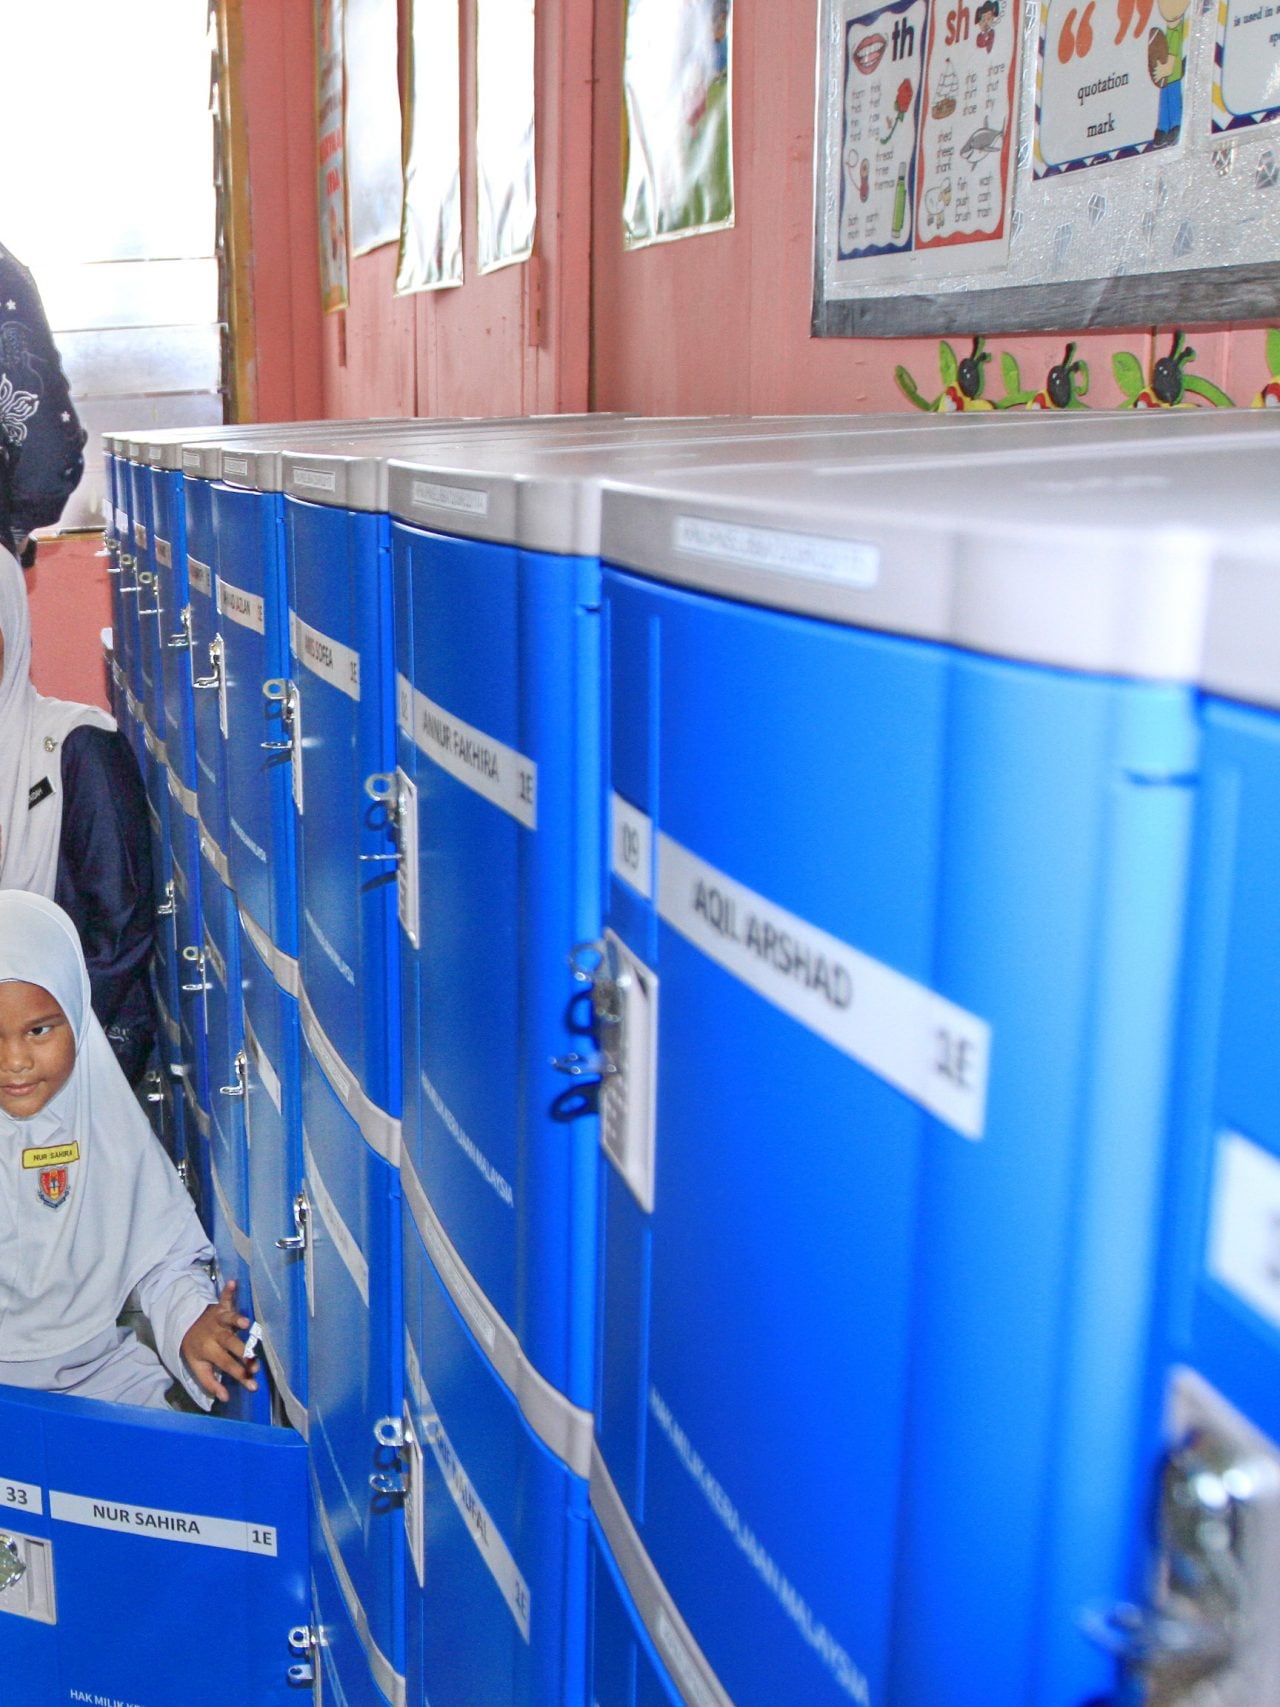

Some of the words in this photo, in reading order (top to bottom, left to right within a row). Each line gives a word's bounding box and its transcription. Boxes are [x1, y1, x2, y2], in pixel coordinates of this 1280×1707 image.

[892, 17, 915, 61] th
[945, 0, 970, 46] sh
[1077, 72, 1129, 106] quotation
[1086, 112, 1116, 138] mark
[422, 708, 452, 753] ANNUR
[453, 729, 500, 783] FAKHIRA
[519, 769, 533, 805] 1E
[744, 904, 854, 1012] ARSHAD
[33, 1153, 48, 1161] NUR
[50, 1149, 73, 1160] SAHIRA
[5, 1486, 28, 1505] 33
[93, 1504, 131, 1524] NUR
[135, 1510, 201, 1535] SAHIRA
[252, 1529, 273, 1546] 1E
[70, 1688, 93, 1704] HAK
